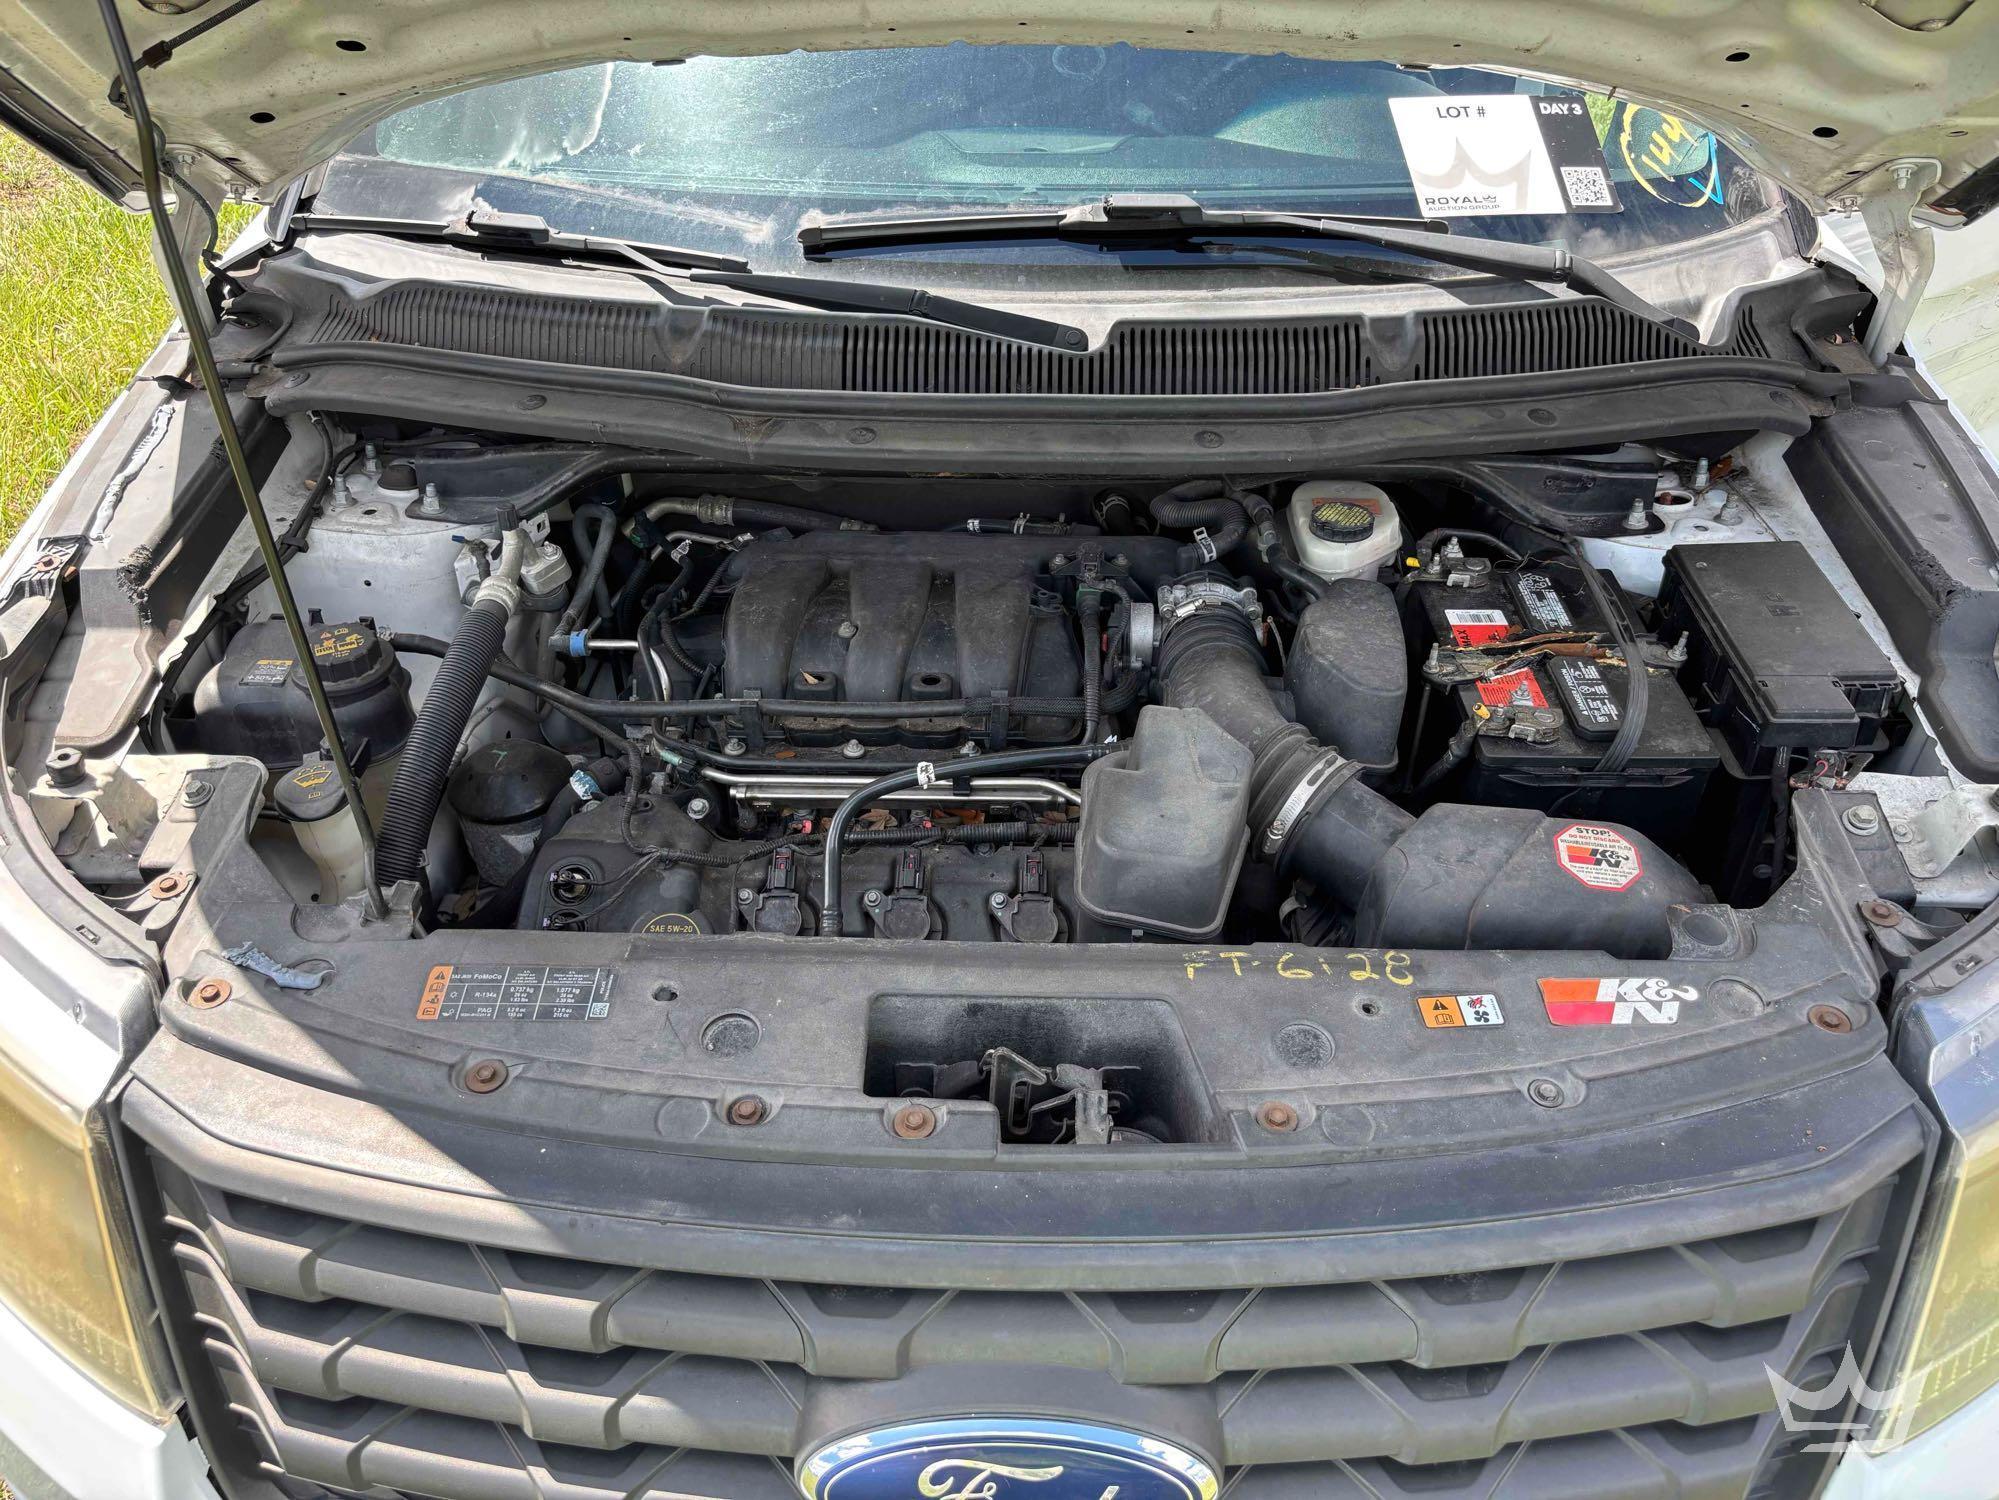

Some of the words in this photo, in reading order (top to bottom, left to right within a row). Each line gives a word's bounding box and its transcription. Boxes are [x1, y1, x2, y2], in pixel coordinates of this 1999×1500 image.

[1437, 106, 1470, 118] LOT
[1477, 105, 1486, 118] #
[1538, 102, 1569, 115] DAY
[1572, 104, 1583, 115] 3
[1424, 196, 1483, 205] ROYAL
[1575, 827, 1611, 837] STOP!
[650, 925, 666, 933] SAE
[667, 925, 693, 933] 5W-20
